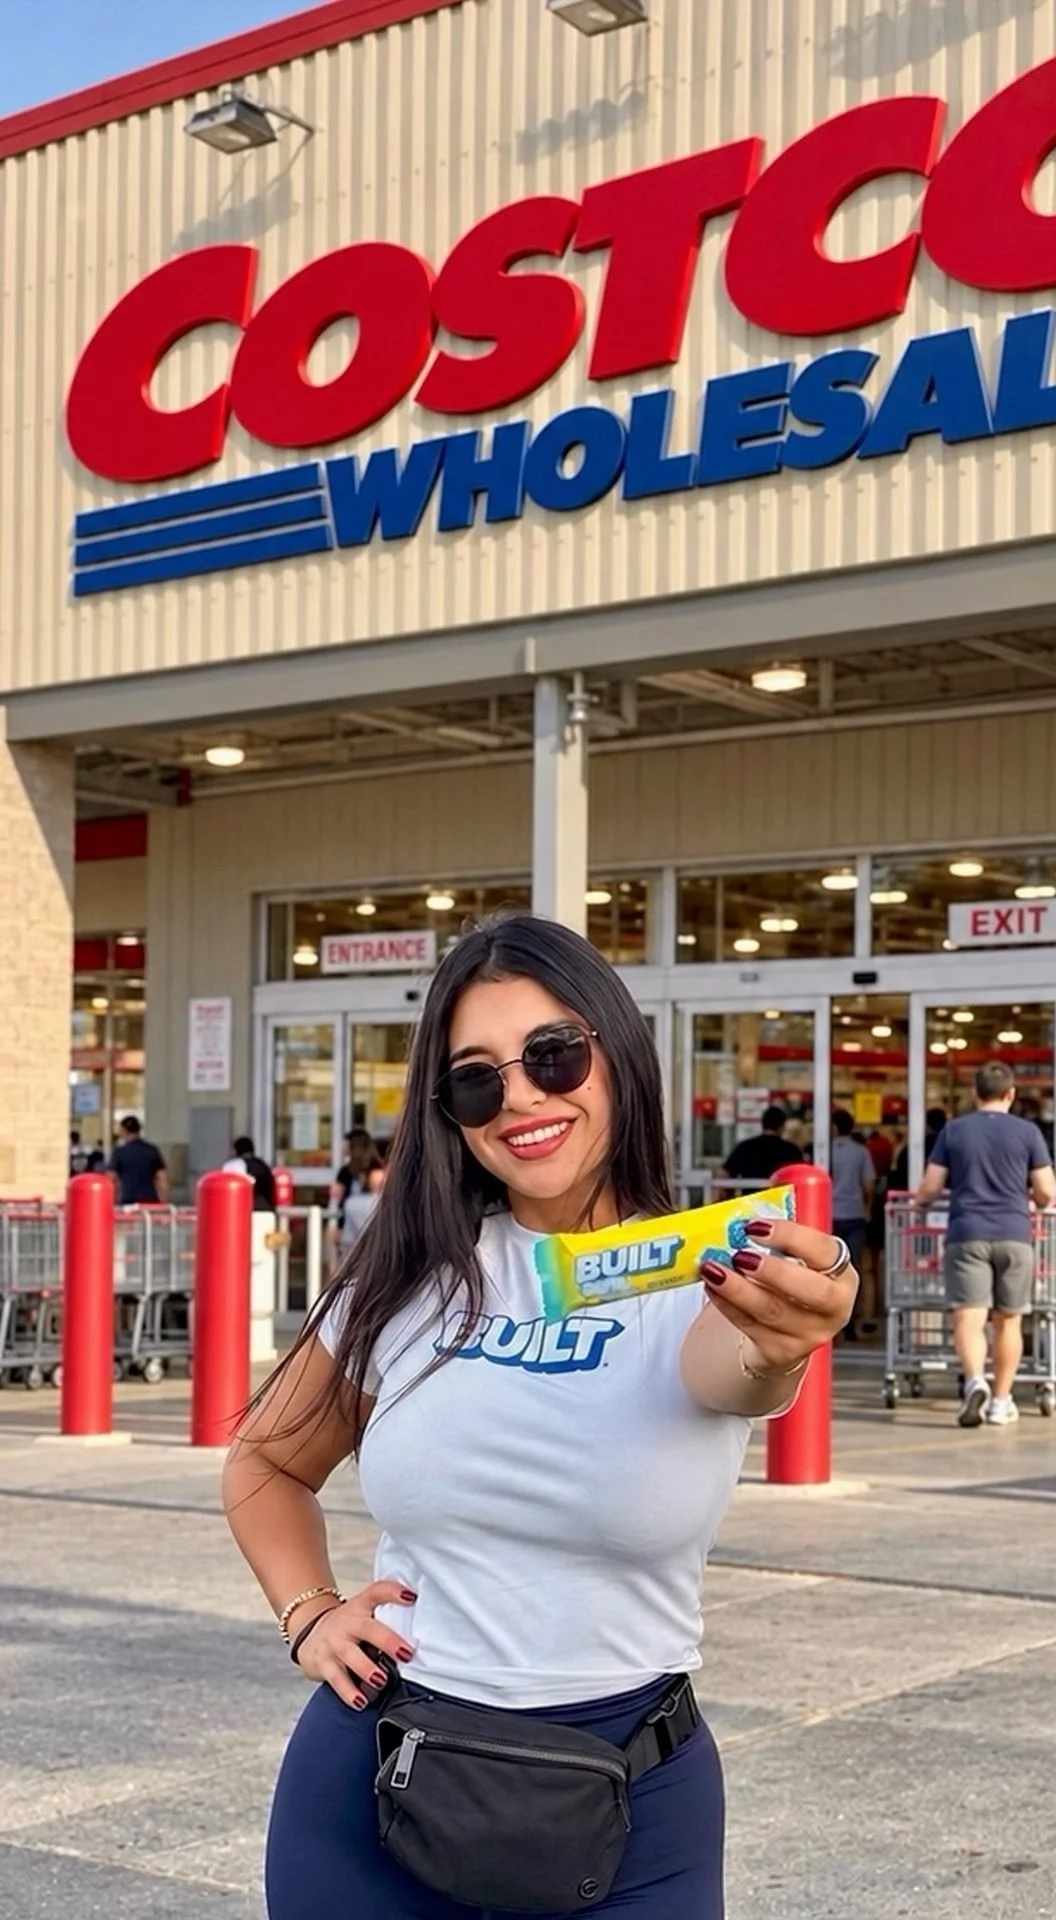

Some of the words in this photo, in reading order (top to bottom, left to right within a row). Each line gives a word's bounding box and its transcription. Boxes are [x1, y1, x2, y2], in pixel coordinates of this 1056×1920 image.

[66, 56, 1056, 482] COSTCO
[971, 906, 1048, 936] EXIT
[327, 938, 427, 965] ENTRANCE
[575, 1234, 685, 1286] BUILT
